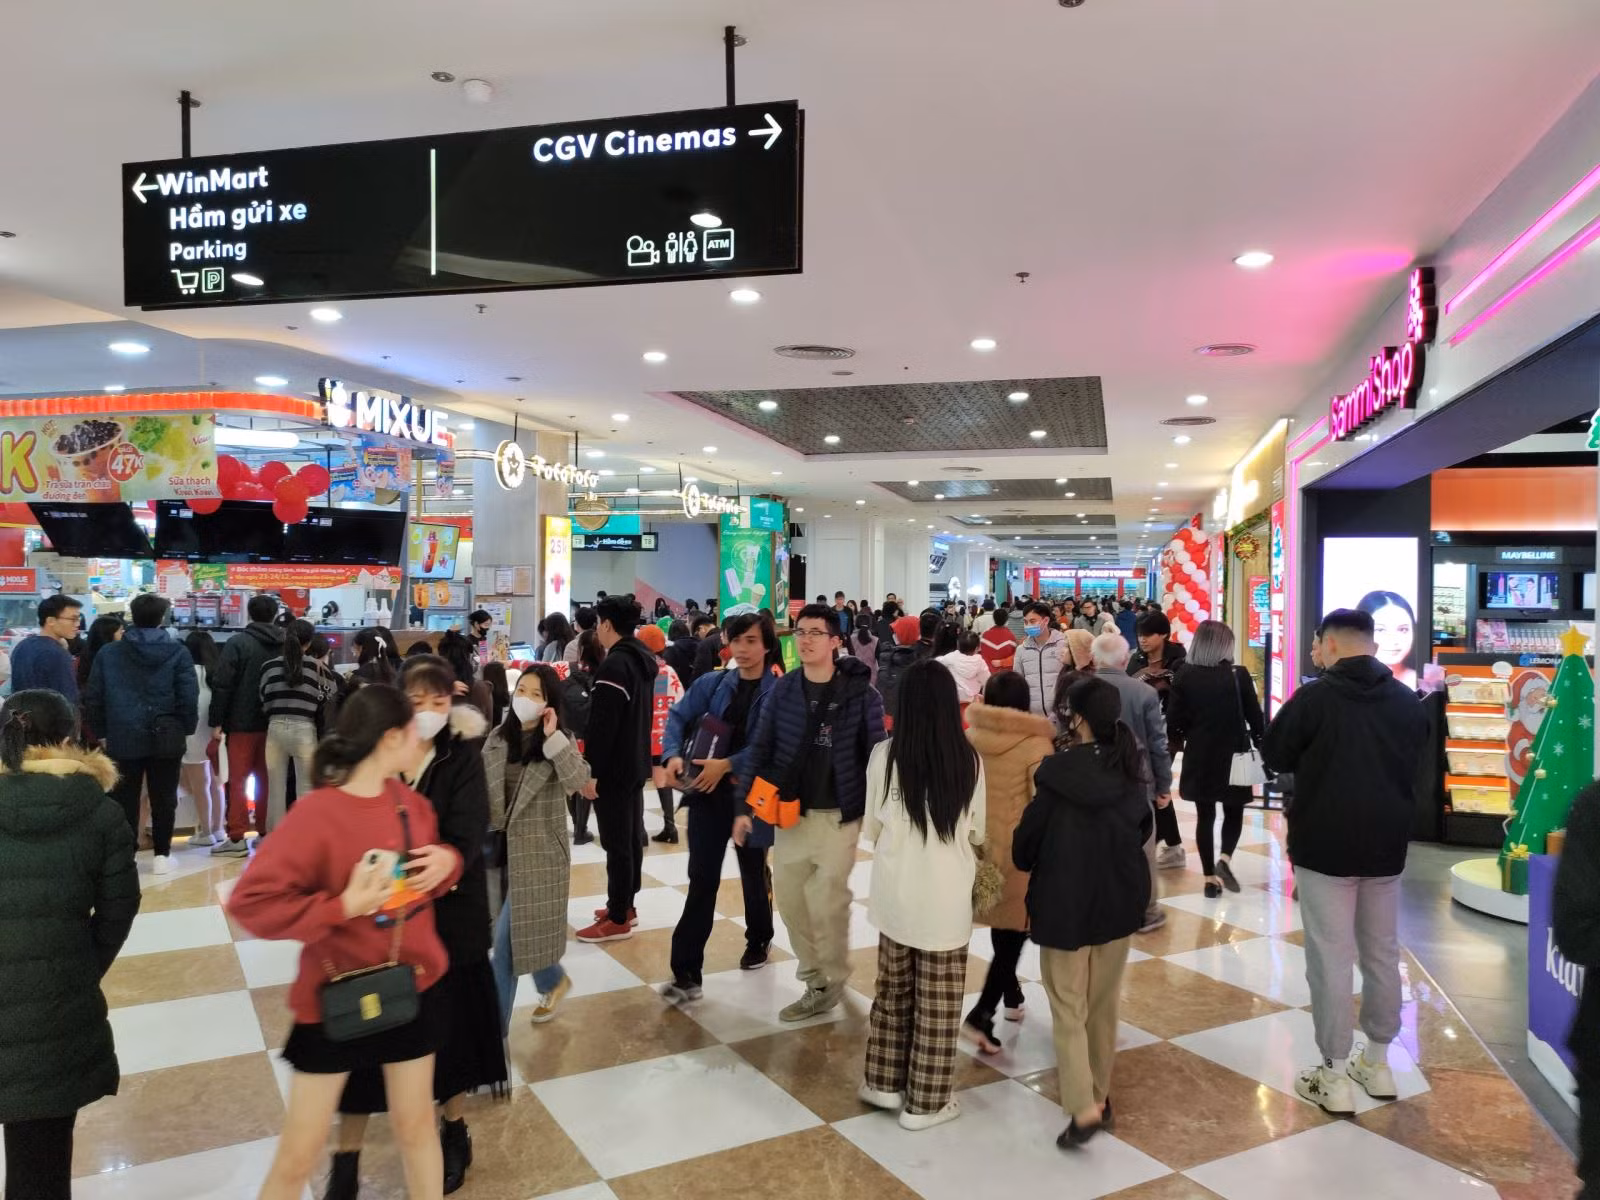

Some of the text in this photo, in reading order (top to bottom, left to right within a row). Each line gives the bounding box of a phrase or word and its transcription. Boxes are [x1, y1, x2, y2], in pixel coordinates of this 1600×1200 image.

[533, 127, 736, 162] CGV Cinemas
[156, 166, 268, 196] WinMart
[169, 200, 307, 230] Hầm gửi xe
[170, 240, 247, 261] Parking
[707, 237, 730, 250] ATM
[356, 391, 449, 447] MIXUE
[111, 453, 144, 475] 47K
[1501, 551, 1556, 560] MAYBELLINE
